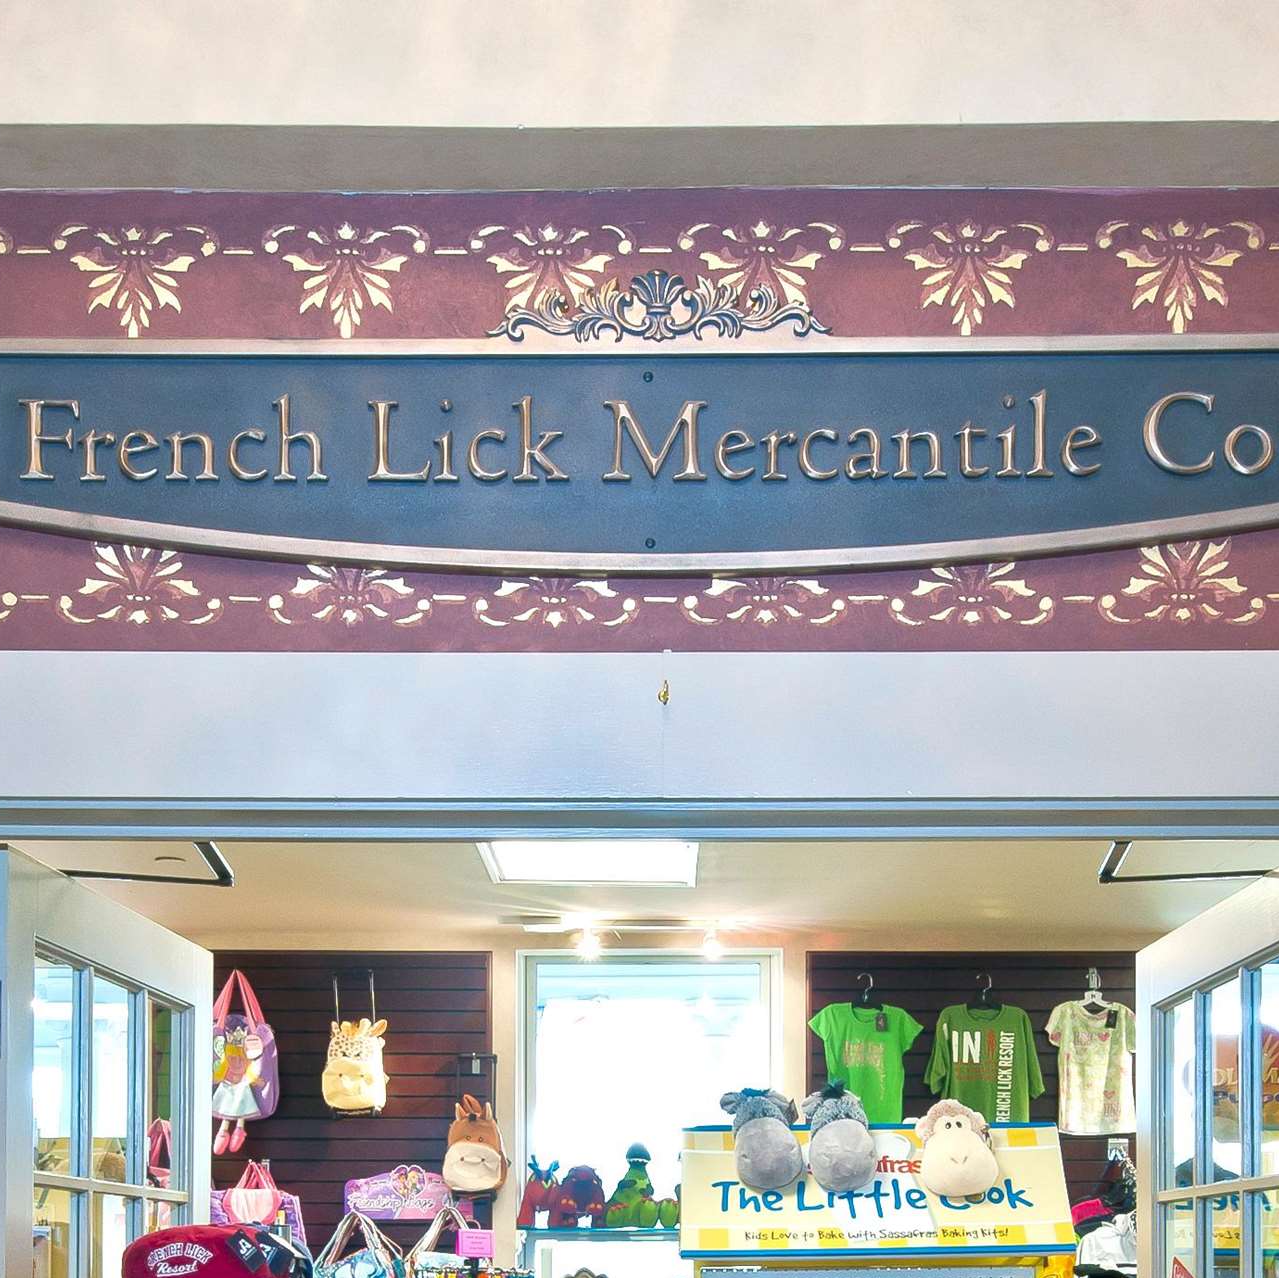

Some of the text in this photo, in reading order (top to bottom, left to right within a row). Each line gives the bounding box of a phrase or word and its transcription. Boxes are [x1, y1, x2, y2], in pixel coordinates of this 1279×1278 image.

[18, 393, 330, 481] French
[365, 394, 568, 481] Lick
[603, 393, 1101, 481] Mercantile
[951, 1030, 981, 1063] IN
[996, 1031, 1015, 1123] RENCH LICK RESORT
[712, 1180, 783, 1212] The
[797, 1178, 928, 1219] Little
[745, 1227, 1009, 1241] Kids Love to Bake with Sassafras Baking Kits!
[156, 1260, 198, 1275] Resort
[184, 1243, 213, 1265] LICK
